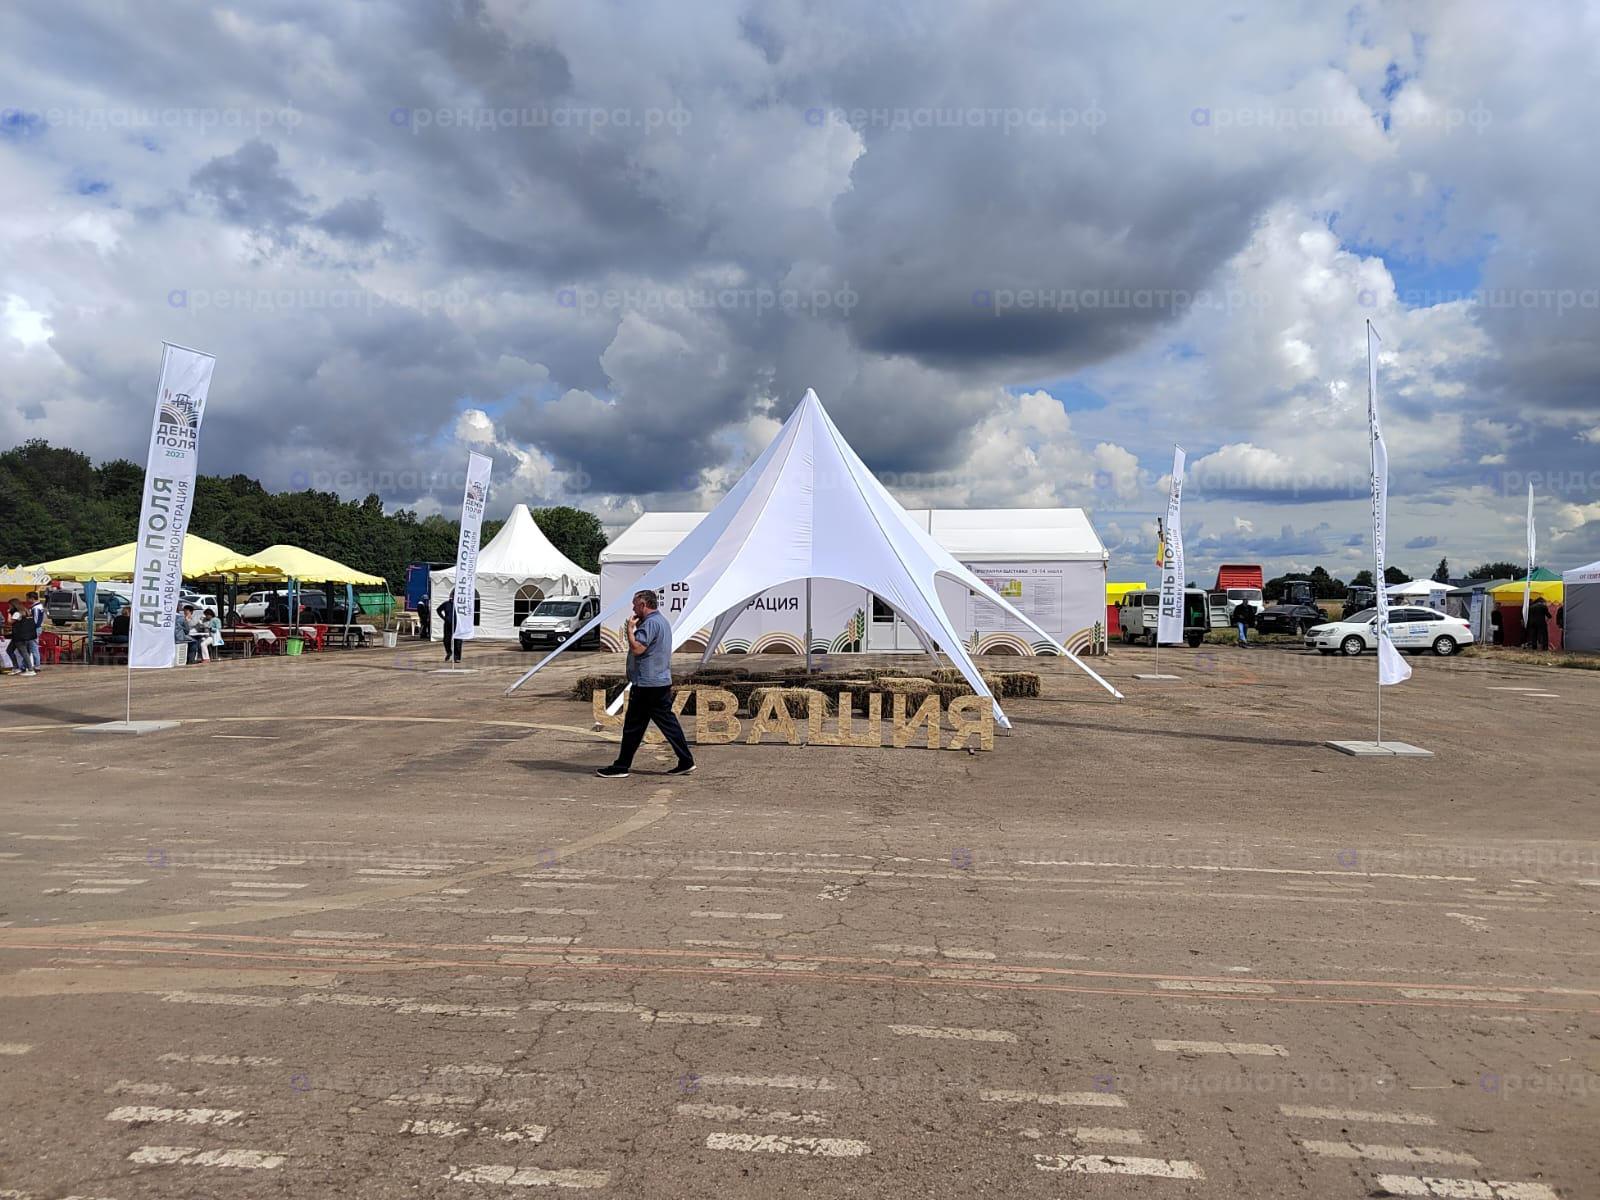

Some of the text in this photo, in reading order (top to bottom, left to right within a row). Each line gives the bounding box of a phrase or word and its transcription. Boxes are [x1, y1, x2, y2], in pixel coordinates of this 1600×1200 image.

[156, 435, 196, 451] ПОЛЯ
[157, 424, 197, 439] ДЕНЬ
[165, 450, 185, 459] 2023
[139, 476, 174, 628] ДЕНЬ ПОЛЯ
[162, 480, 189, 628] ВЫСТАВКА-ДЕМОНСТРАЦИЯ
[457, 529, 471, 616] ДЕНЬ ПОЛЯ
[1162, 575, 1175, 618] ДЕНЬ
